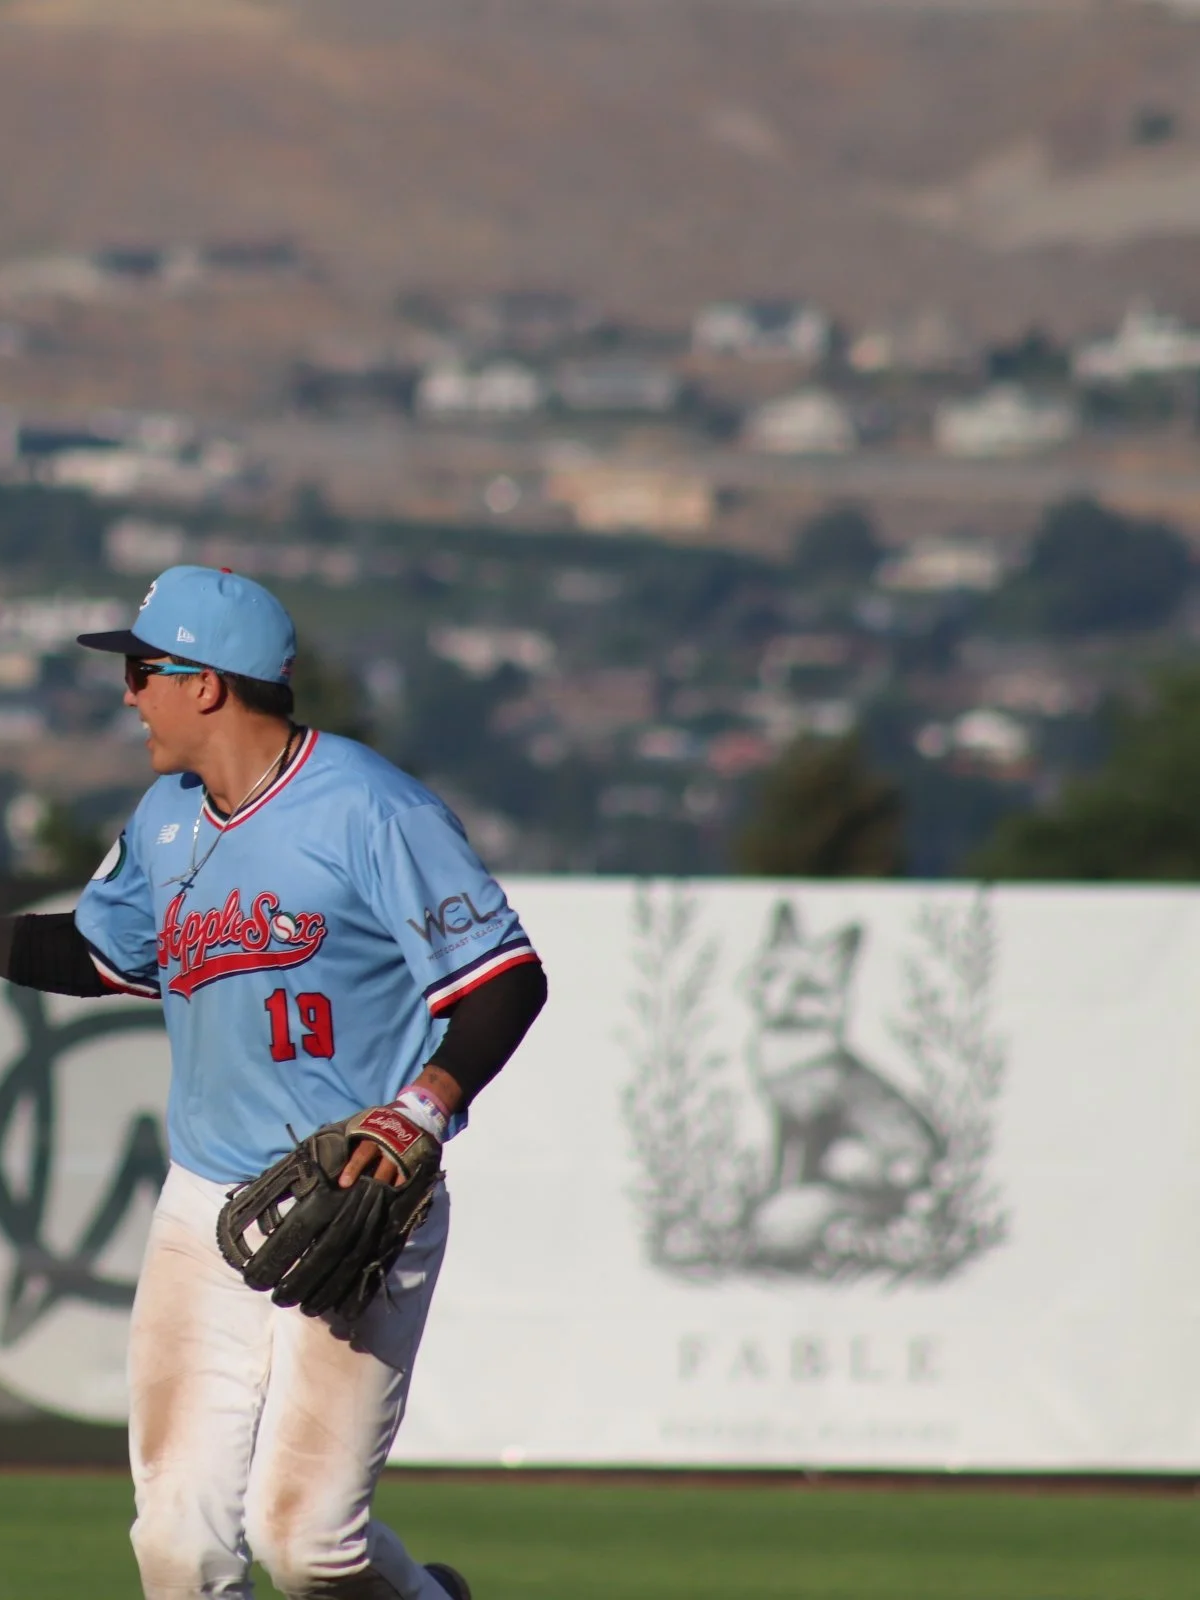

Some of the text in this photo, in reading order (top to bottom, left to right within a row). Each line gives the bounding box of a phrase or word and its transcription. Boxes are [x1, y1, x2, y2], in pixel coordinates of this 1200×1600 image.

[406, 892, 497, 947] WCL
[264, 988, 335, 1062] 19
[677, 1333, 944, 1382] FABLE
